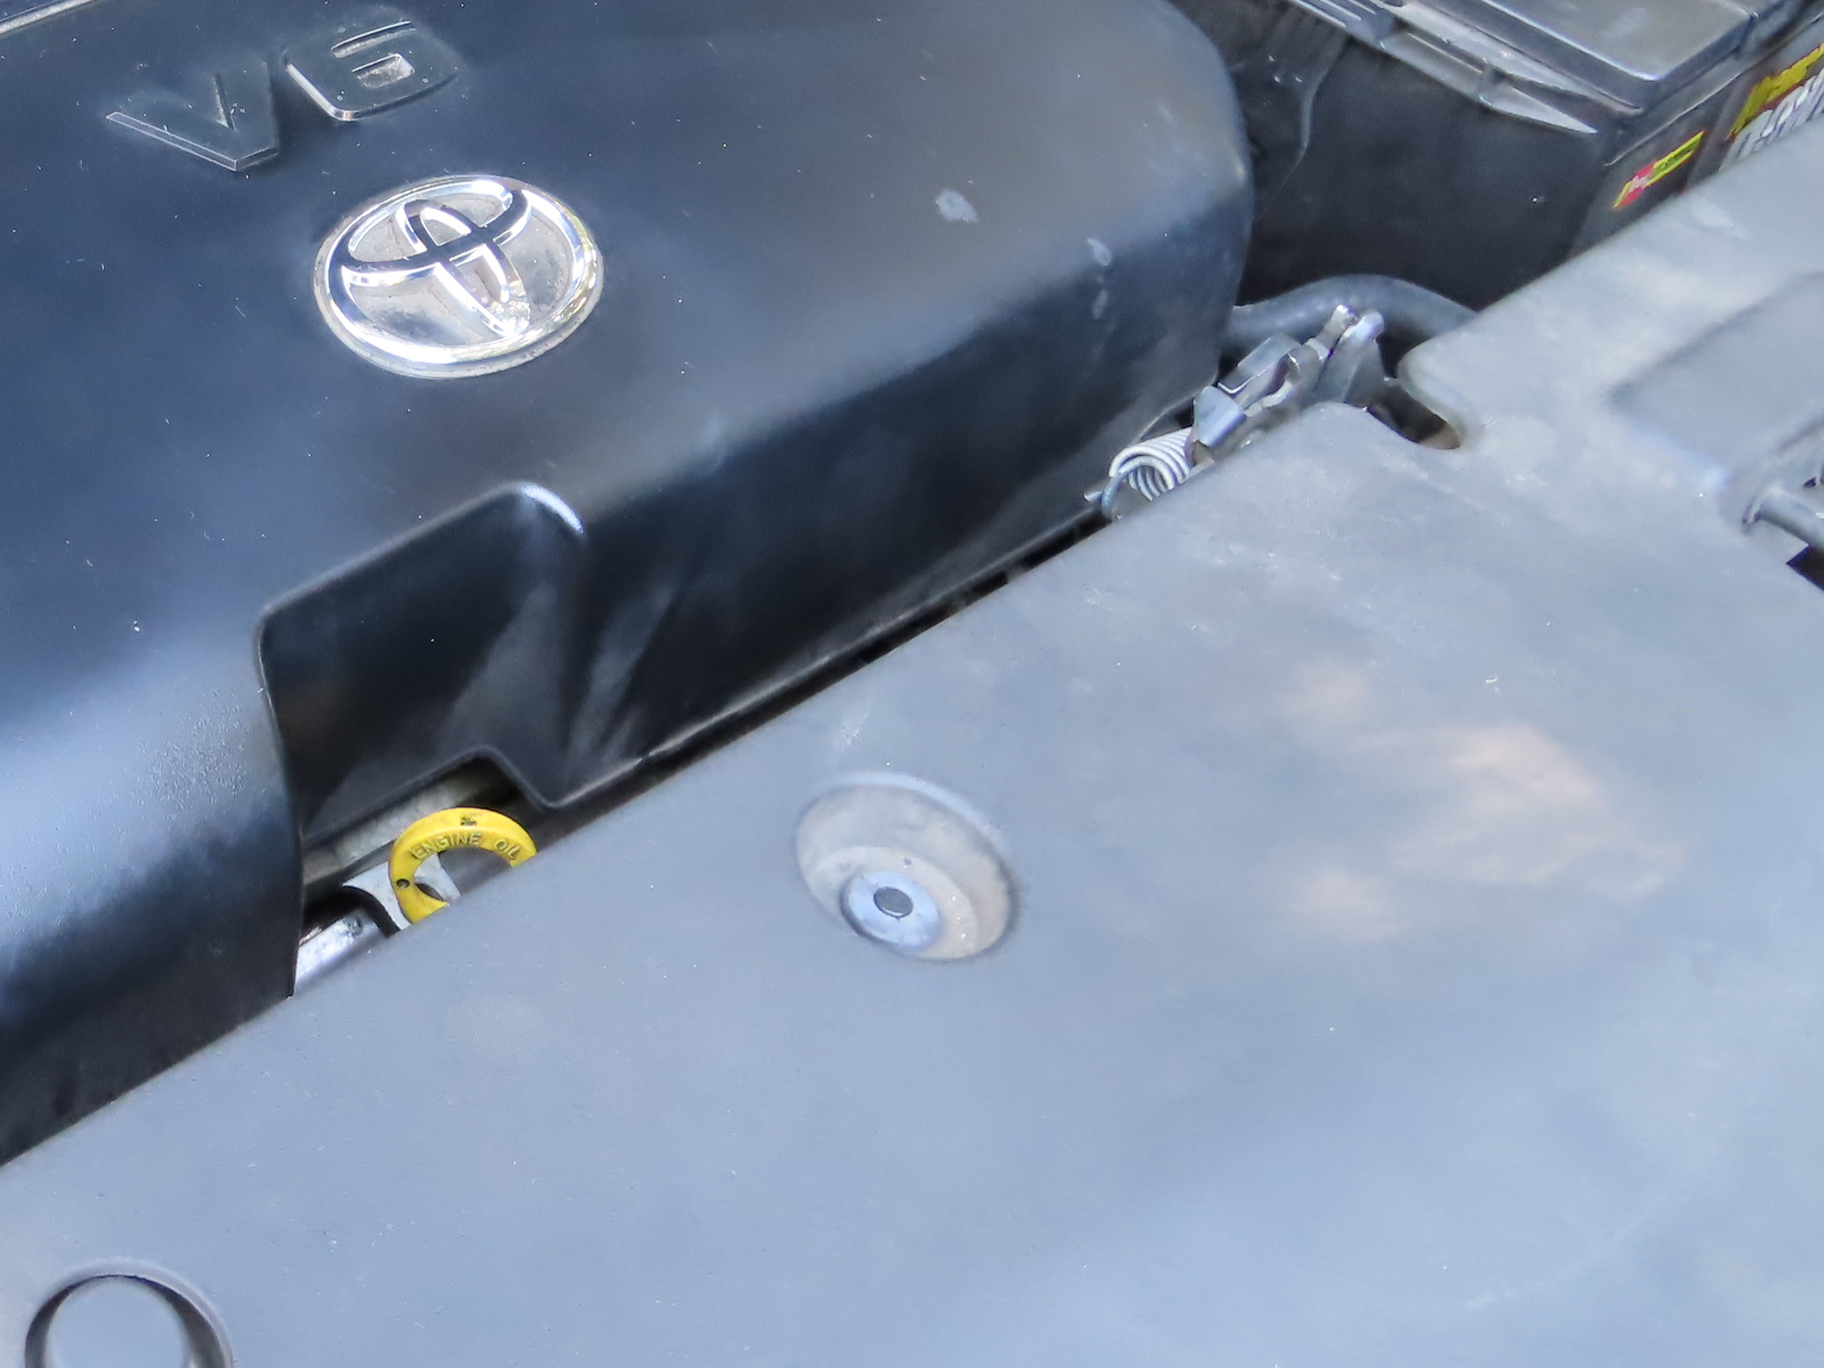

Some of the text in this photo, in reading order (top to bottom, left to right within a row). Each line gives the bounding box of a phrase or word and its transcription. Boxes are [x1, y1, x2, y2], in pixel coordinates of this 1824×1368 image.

[106, 6, 464, 172] V6
[409, 831, 522, 860] ENGINE OIL
